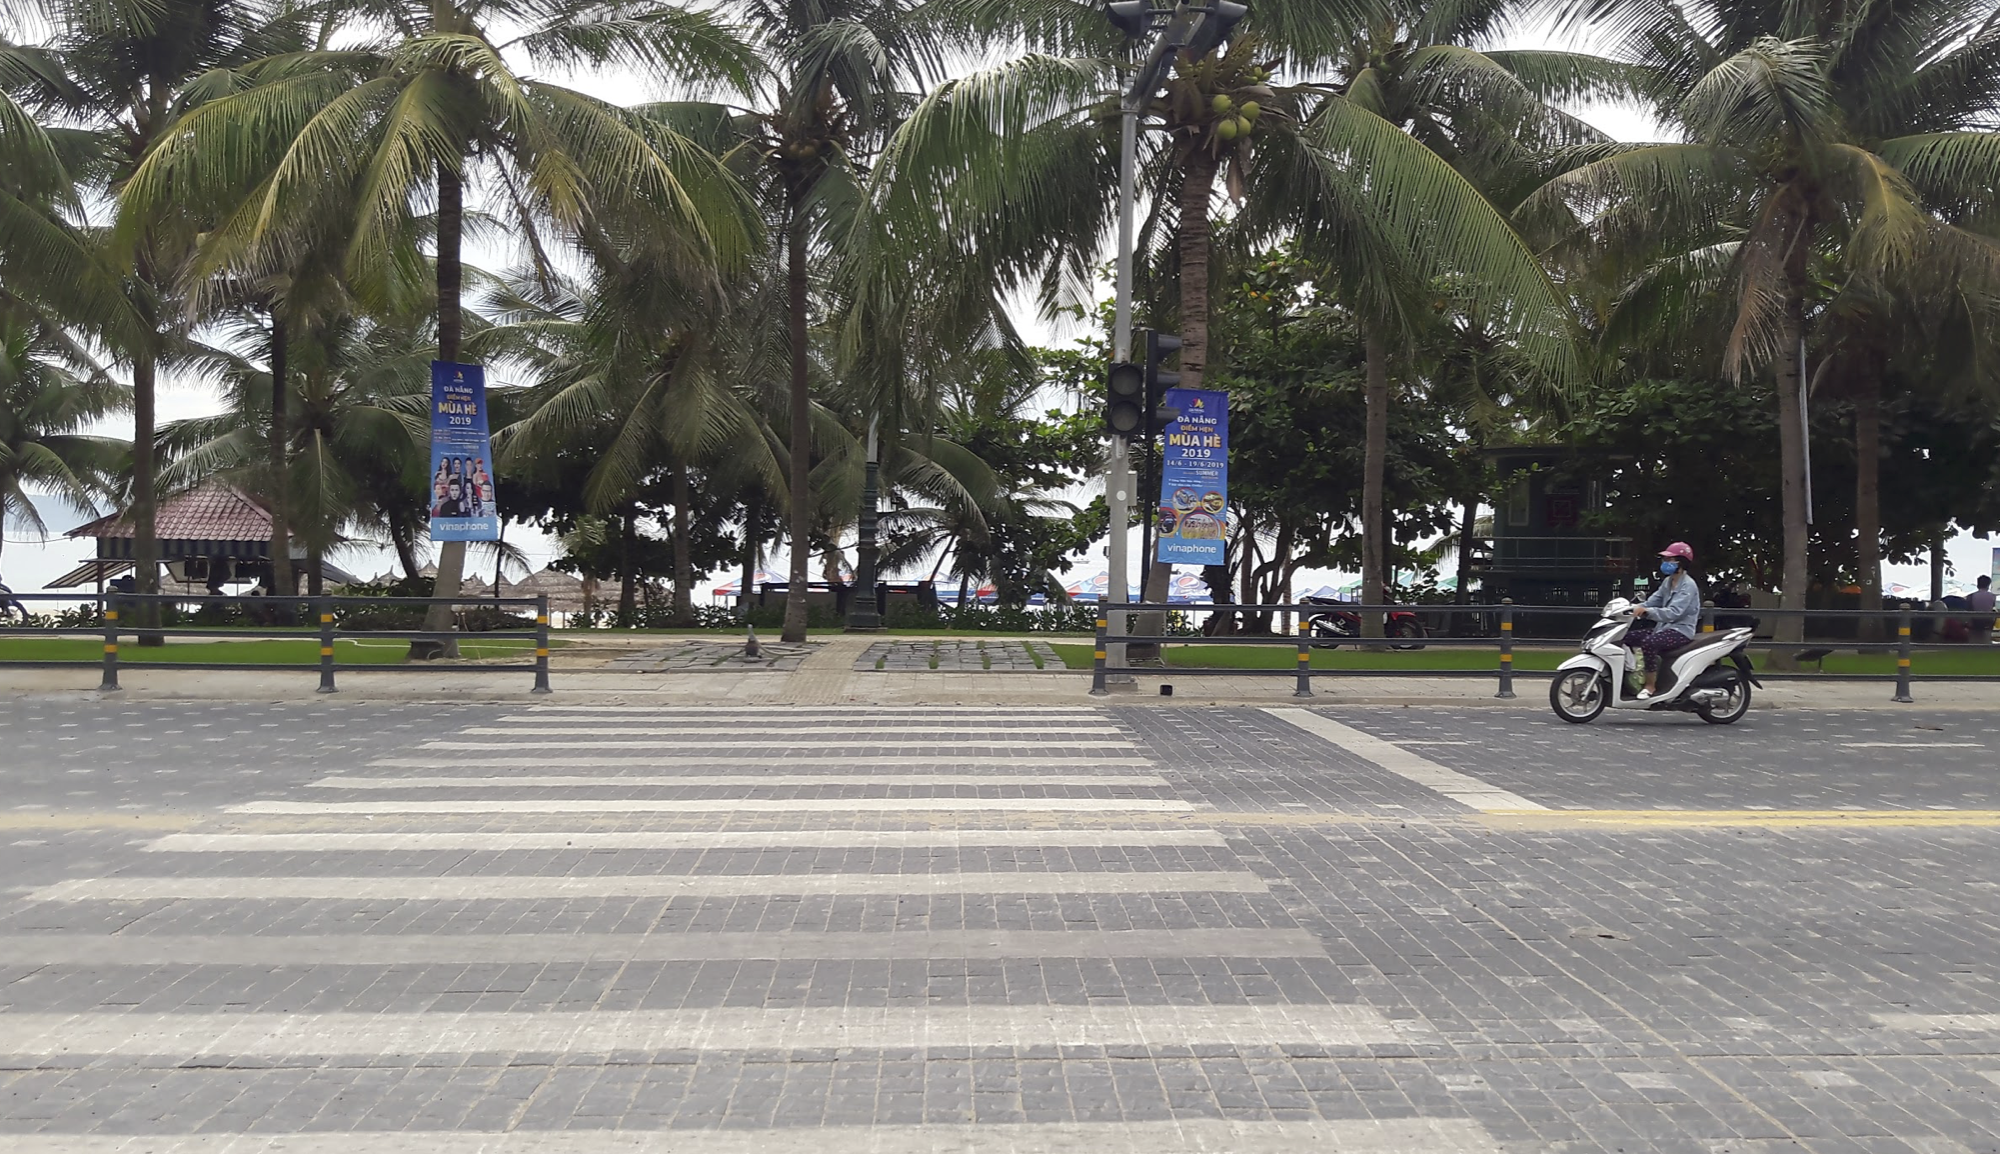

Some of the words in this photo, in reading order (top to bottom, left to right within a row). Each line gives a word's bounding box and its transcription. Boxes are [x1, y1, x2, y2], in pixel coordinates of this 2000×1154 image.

[438, 401, 463, 414] MÙA
[464, 402, 477, 415] HÈ
[449, 416, 471, 425] 2019
[1177, 415, 1190, 423] ĐÀ
[1169, 432, 1200, 447] MÙA
[1203, 433, 1222, 448] HÈ
[1181, 448, 1211, 458] 2019
[439, 522, 488, 532] vinaphone
[1167, 543, 1217, 554] vinaphone
